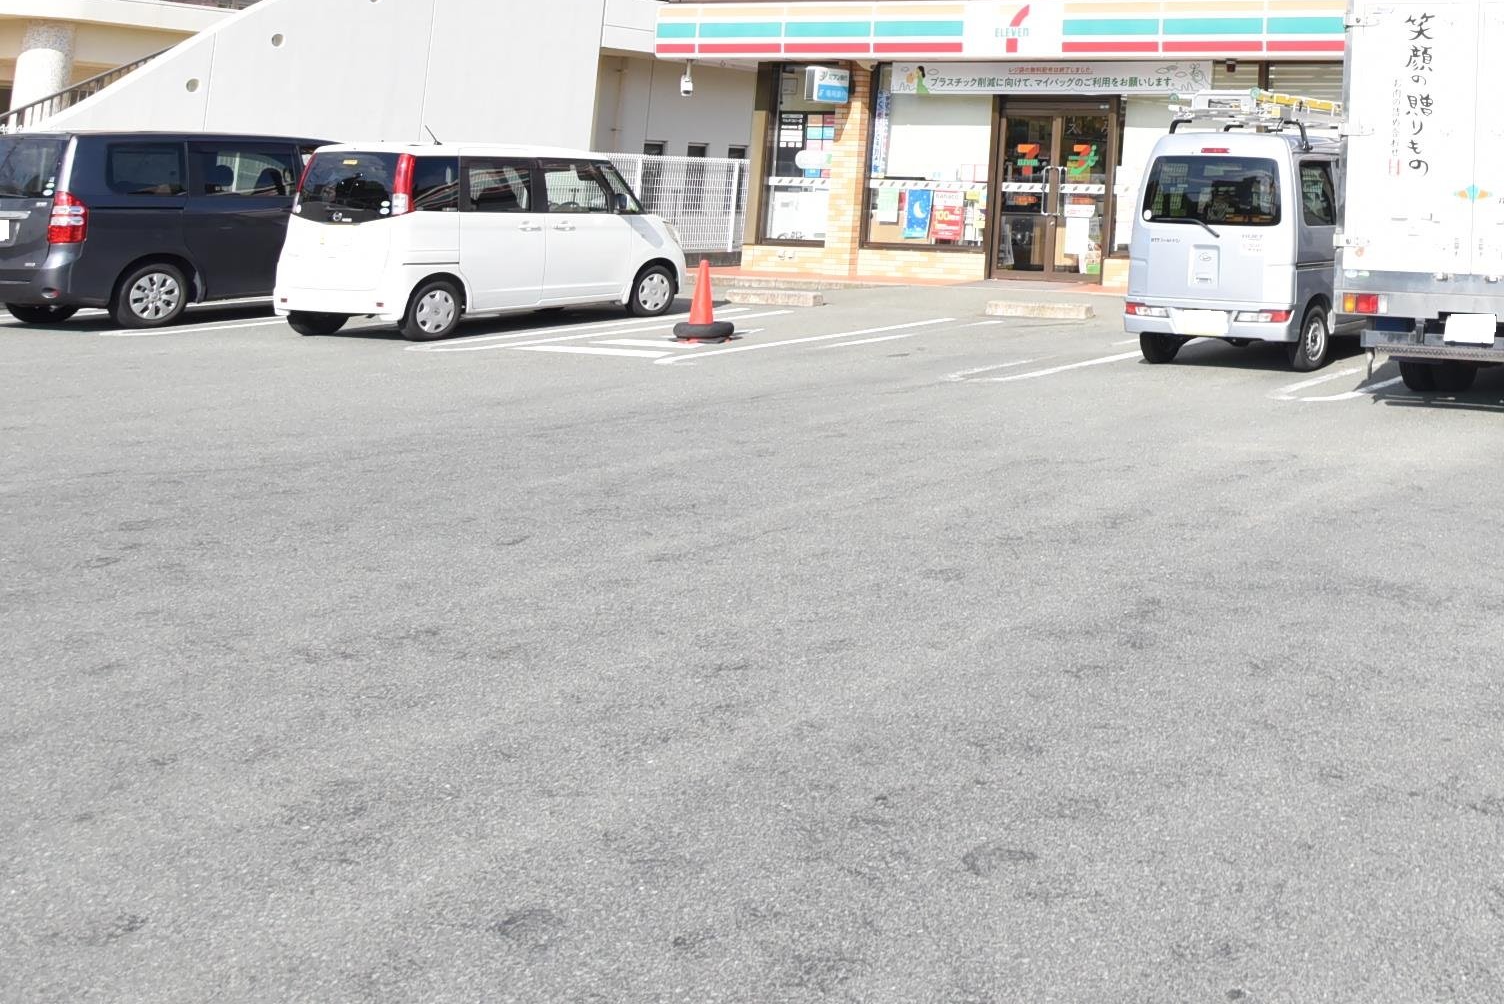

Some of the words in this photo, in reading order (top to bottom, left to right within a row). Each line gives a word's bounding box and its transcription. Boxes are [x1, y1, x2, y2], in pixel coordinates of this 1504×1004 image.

[1405, 12, 1435, 177] 笑顔の贈りもの
